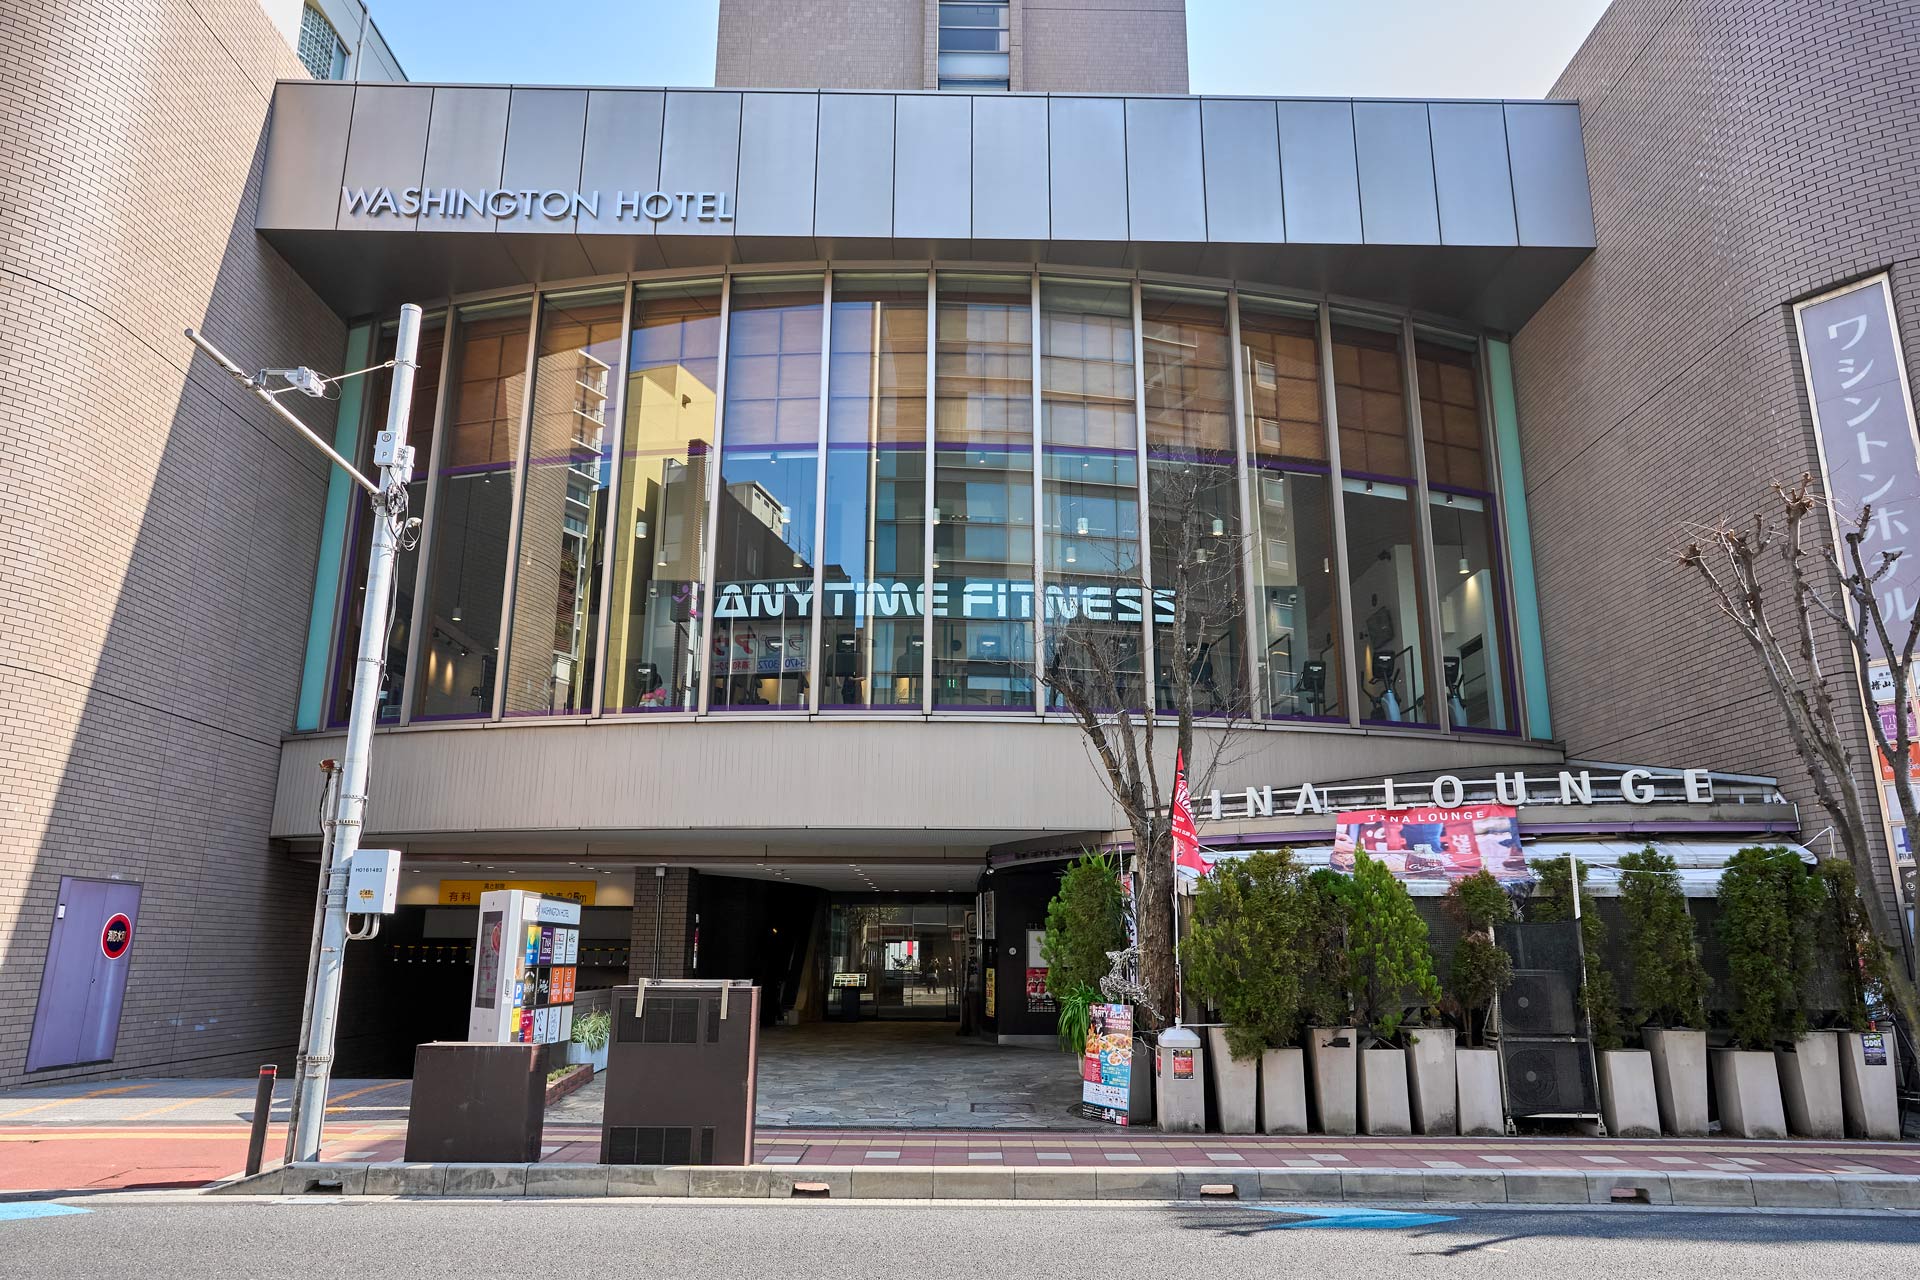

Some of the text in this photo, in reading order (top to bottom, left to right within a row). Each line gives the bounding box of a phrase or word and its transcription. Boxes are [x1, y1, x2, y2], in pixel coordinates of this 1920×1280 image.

[342, 186, 733, 221] WASHINGTON HOTEL
[1827, 313, 1916, 625] ワシントンホテル
[713, 582, 1176, 622] ANYTIME FITNESS
[1384, 768, 1715, 811] LOUNGE
[1367, 810, 1486, 824] TINA LOUNGE
